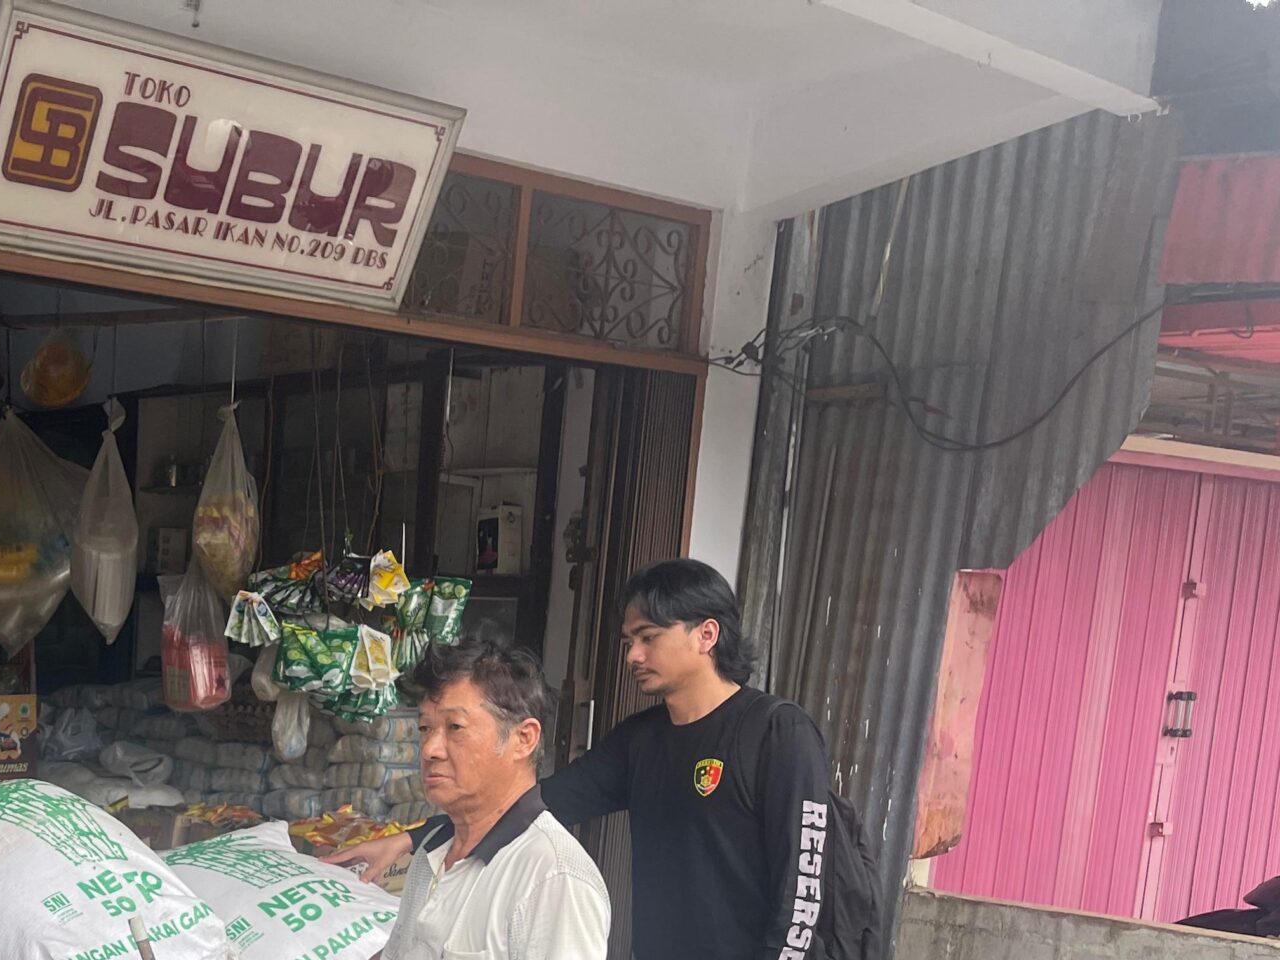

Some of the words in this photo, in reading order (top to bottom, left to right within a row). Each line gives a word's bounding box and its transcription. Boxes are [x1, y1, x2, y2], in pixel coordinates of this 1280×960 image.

[124, 71, 191, 108] TOKO
[96, 101, 417, 248] SUBUR
[130, 205, 207, 237] PASAR
[214, 220, 268, 249] IKAN
[271, 233, 346, 263] NO.209
[350, 246, 389, 270] DBS
[43, 893, 71, 913] SNI
[101, 896, 137, 917] 50
[257, 879, 351, 918] NETTO
[225, 917, 252, 940] SNI
[282, 903, 322, 933] 50
[312, 916, 373, 960] PAKAI
